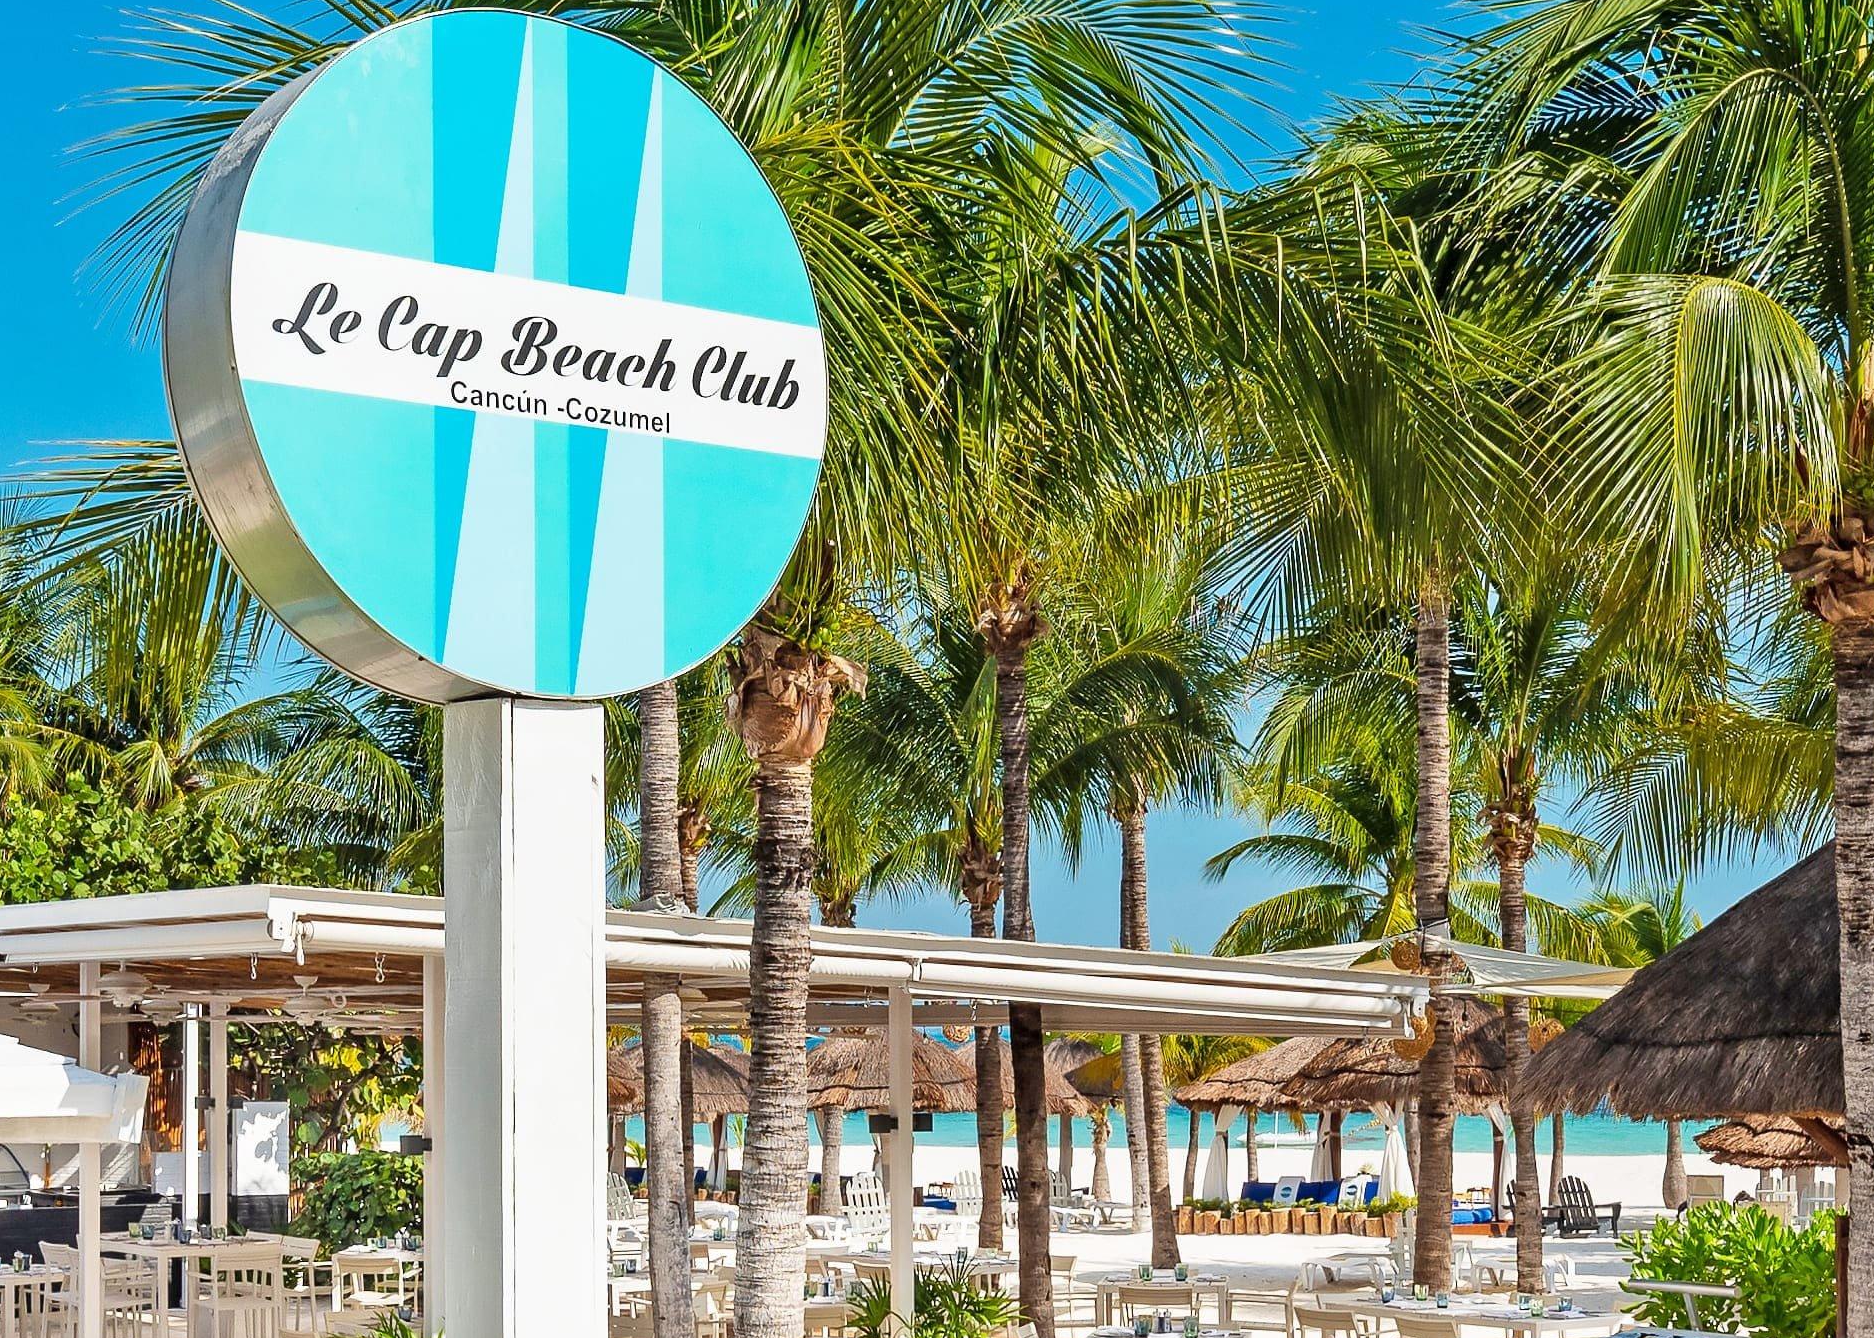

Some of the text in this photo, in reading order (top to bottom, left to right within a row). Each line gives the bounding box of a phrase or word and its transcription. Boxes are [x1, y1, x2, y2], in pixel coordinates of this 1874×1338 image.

[272, 282, 800, 410] Le Cap Beach Club
[450, 380, 547, 415] Cancún
